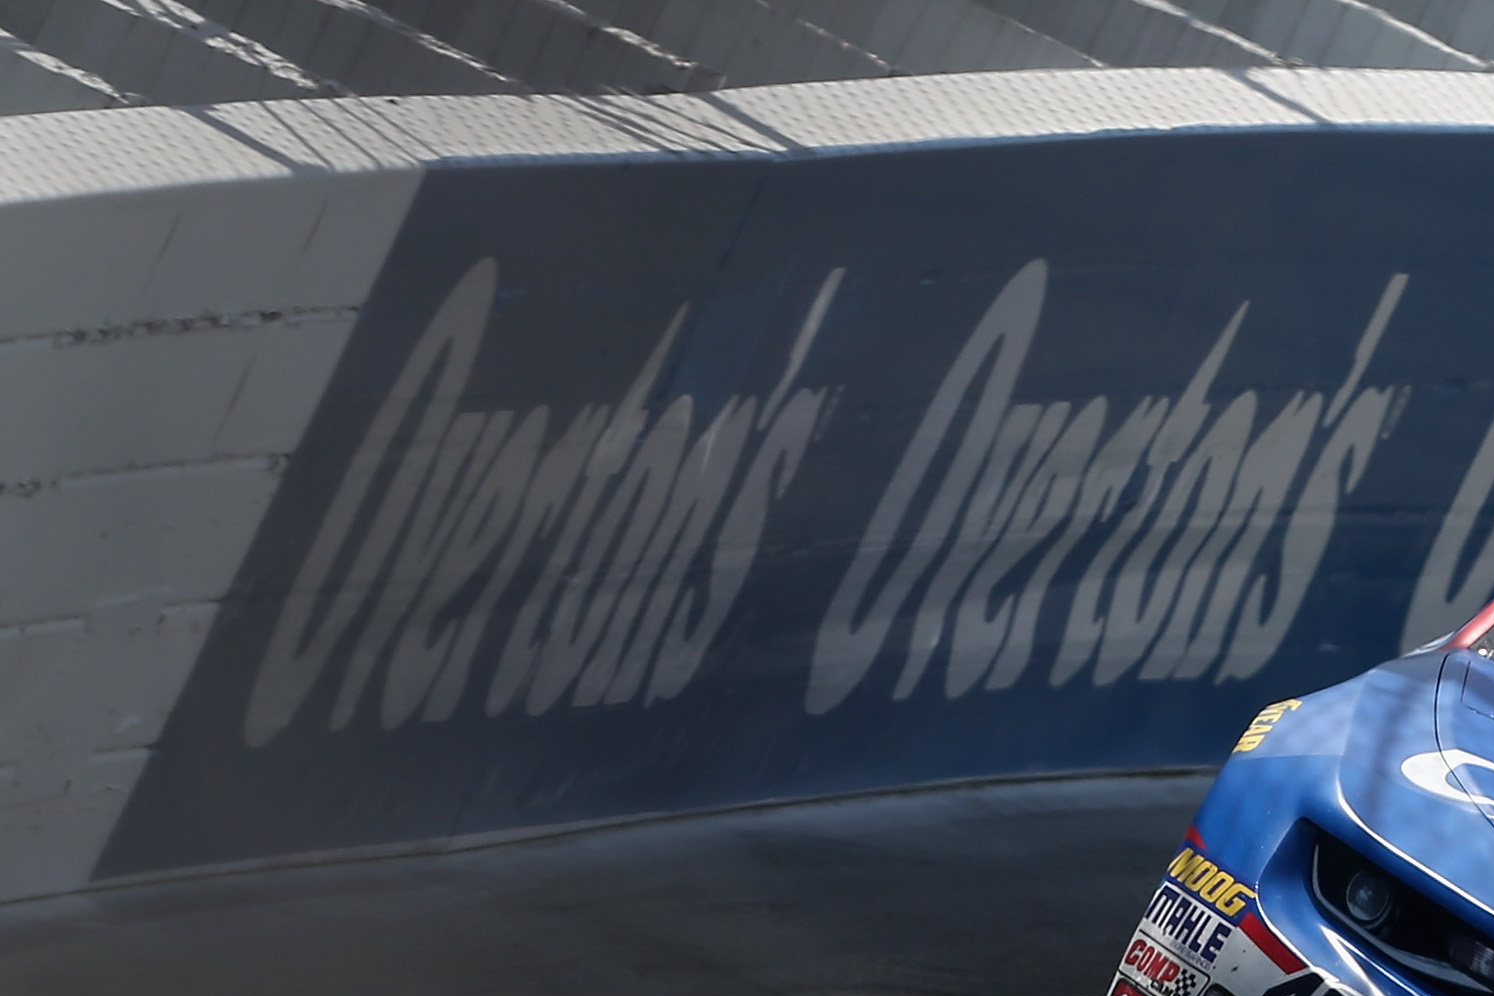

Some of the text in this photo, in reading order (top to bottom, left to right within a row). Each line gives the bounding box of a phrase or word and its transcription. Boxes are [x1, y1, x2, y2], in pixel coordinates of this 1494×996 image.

[805, 258, 1411, 716] Overton's
[1168, 847, 1257, 917] MOOG
[1145, 885, 1232, 963] MAHLE
[1125, 939, 1180, 984] COMP
